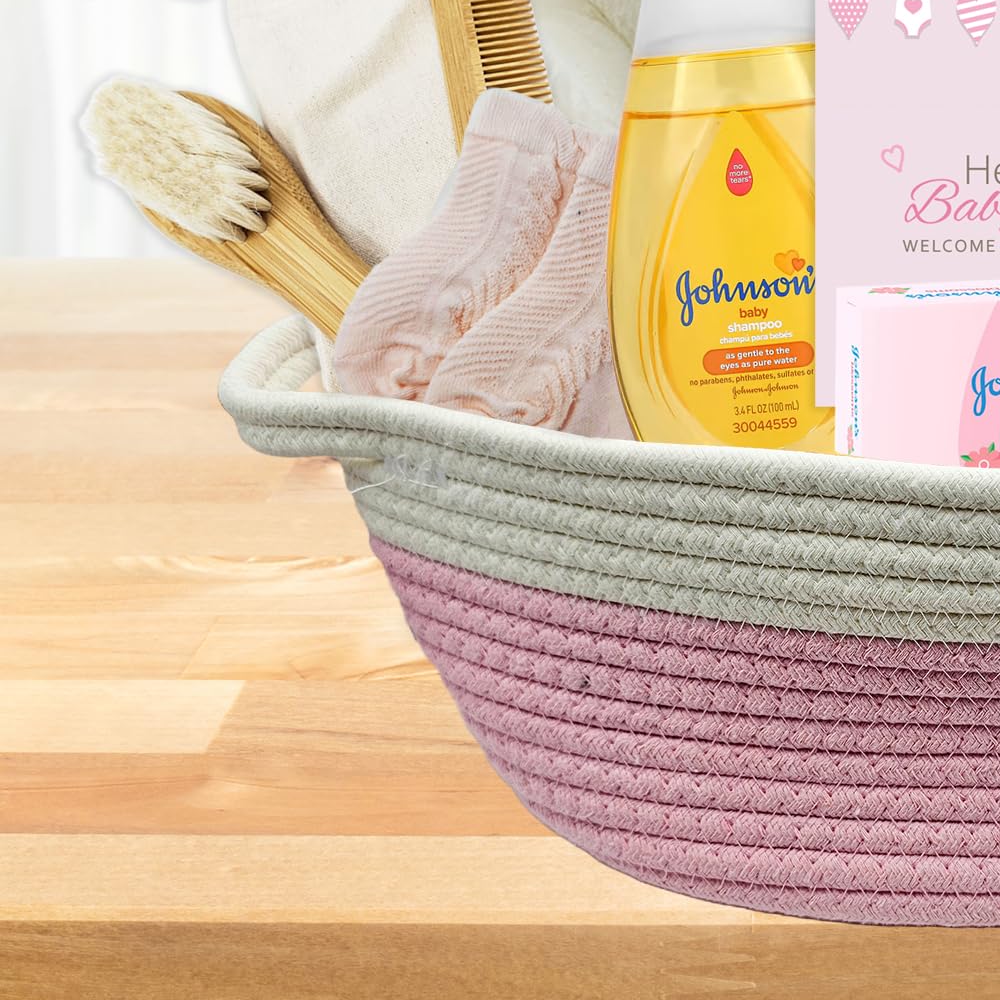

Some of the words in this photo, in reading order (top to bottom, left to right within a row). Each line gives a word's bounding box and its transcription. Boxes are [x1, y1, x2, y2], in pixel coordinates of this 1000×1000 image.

[902, 239, 996, 253] WELCOME
[676, 265, 815, 326] Johnson'
[739, 306, 769, 319] baby
[727, 319, 783, 333] shampoo
[737, 349, 764, 360] gentle
[765, 348, 775, 356] to
[776, 346, 791, 355] the
[719, 361, 739, 371] eyes
[752, 359, 773, 369] pure
[773, 356, 798, 366] water
[699, 376, 735, 387] parabens,
[735, 373, 776, 384] phthalates,
[776, 369, 806, 379] sulfates
[734, 405, 746, 416] 3.4
[746, 405, 757, 415] FL
[757, 404, 768, 414] OZ
[784, 399, 800, 411] mL)
[732, 416, 798, 434] 30044559
